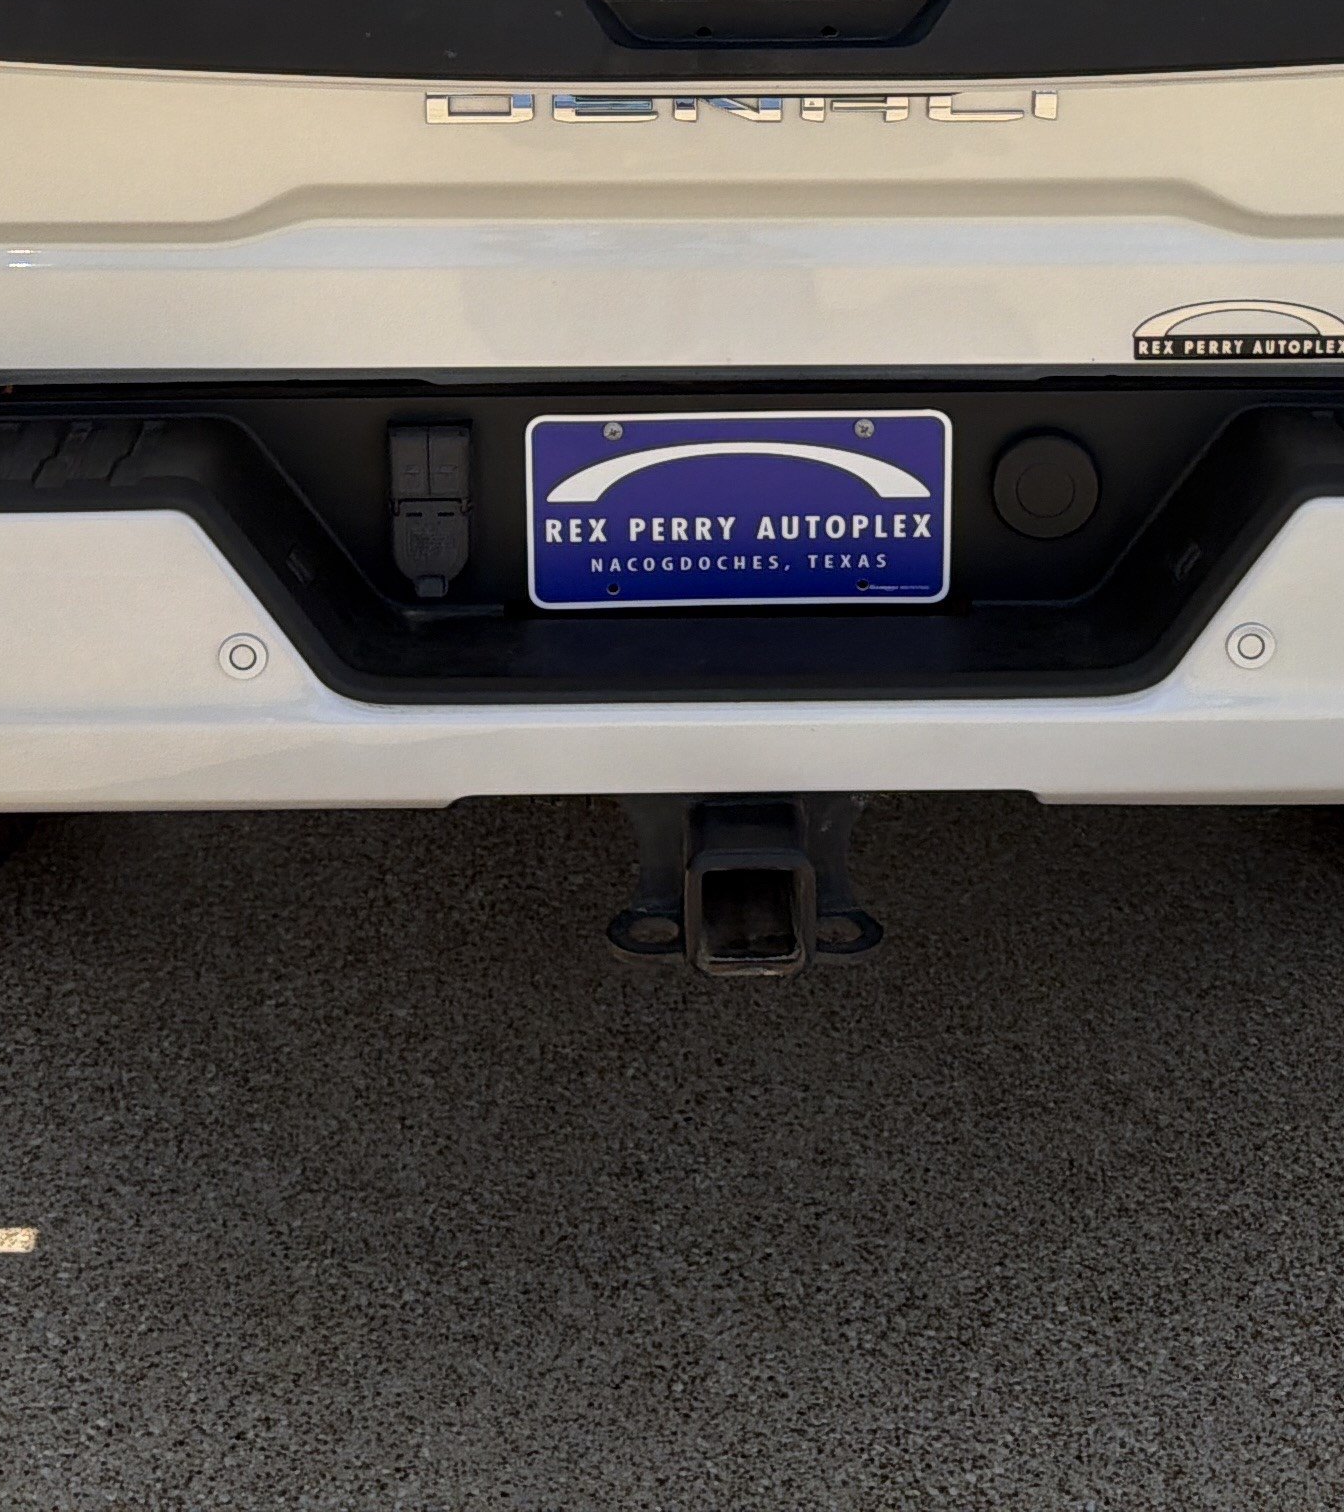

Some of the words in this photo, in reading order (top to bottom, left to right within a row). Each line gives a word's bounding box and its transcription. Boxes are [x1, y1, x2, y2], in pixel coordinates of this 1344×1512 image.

[1138, 340, 1174, 356] REX
[1183, 339, 1245, 355] PERRY
[545, 518, 608, 544] REX
[629, 516, 737, 542] PERRY
[756, 513, 933, 541] AUTOPLEX
[590, 554, 792, 574] NACOGDOCHES,
[808, 553, 889, 571] TEXAS
